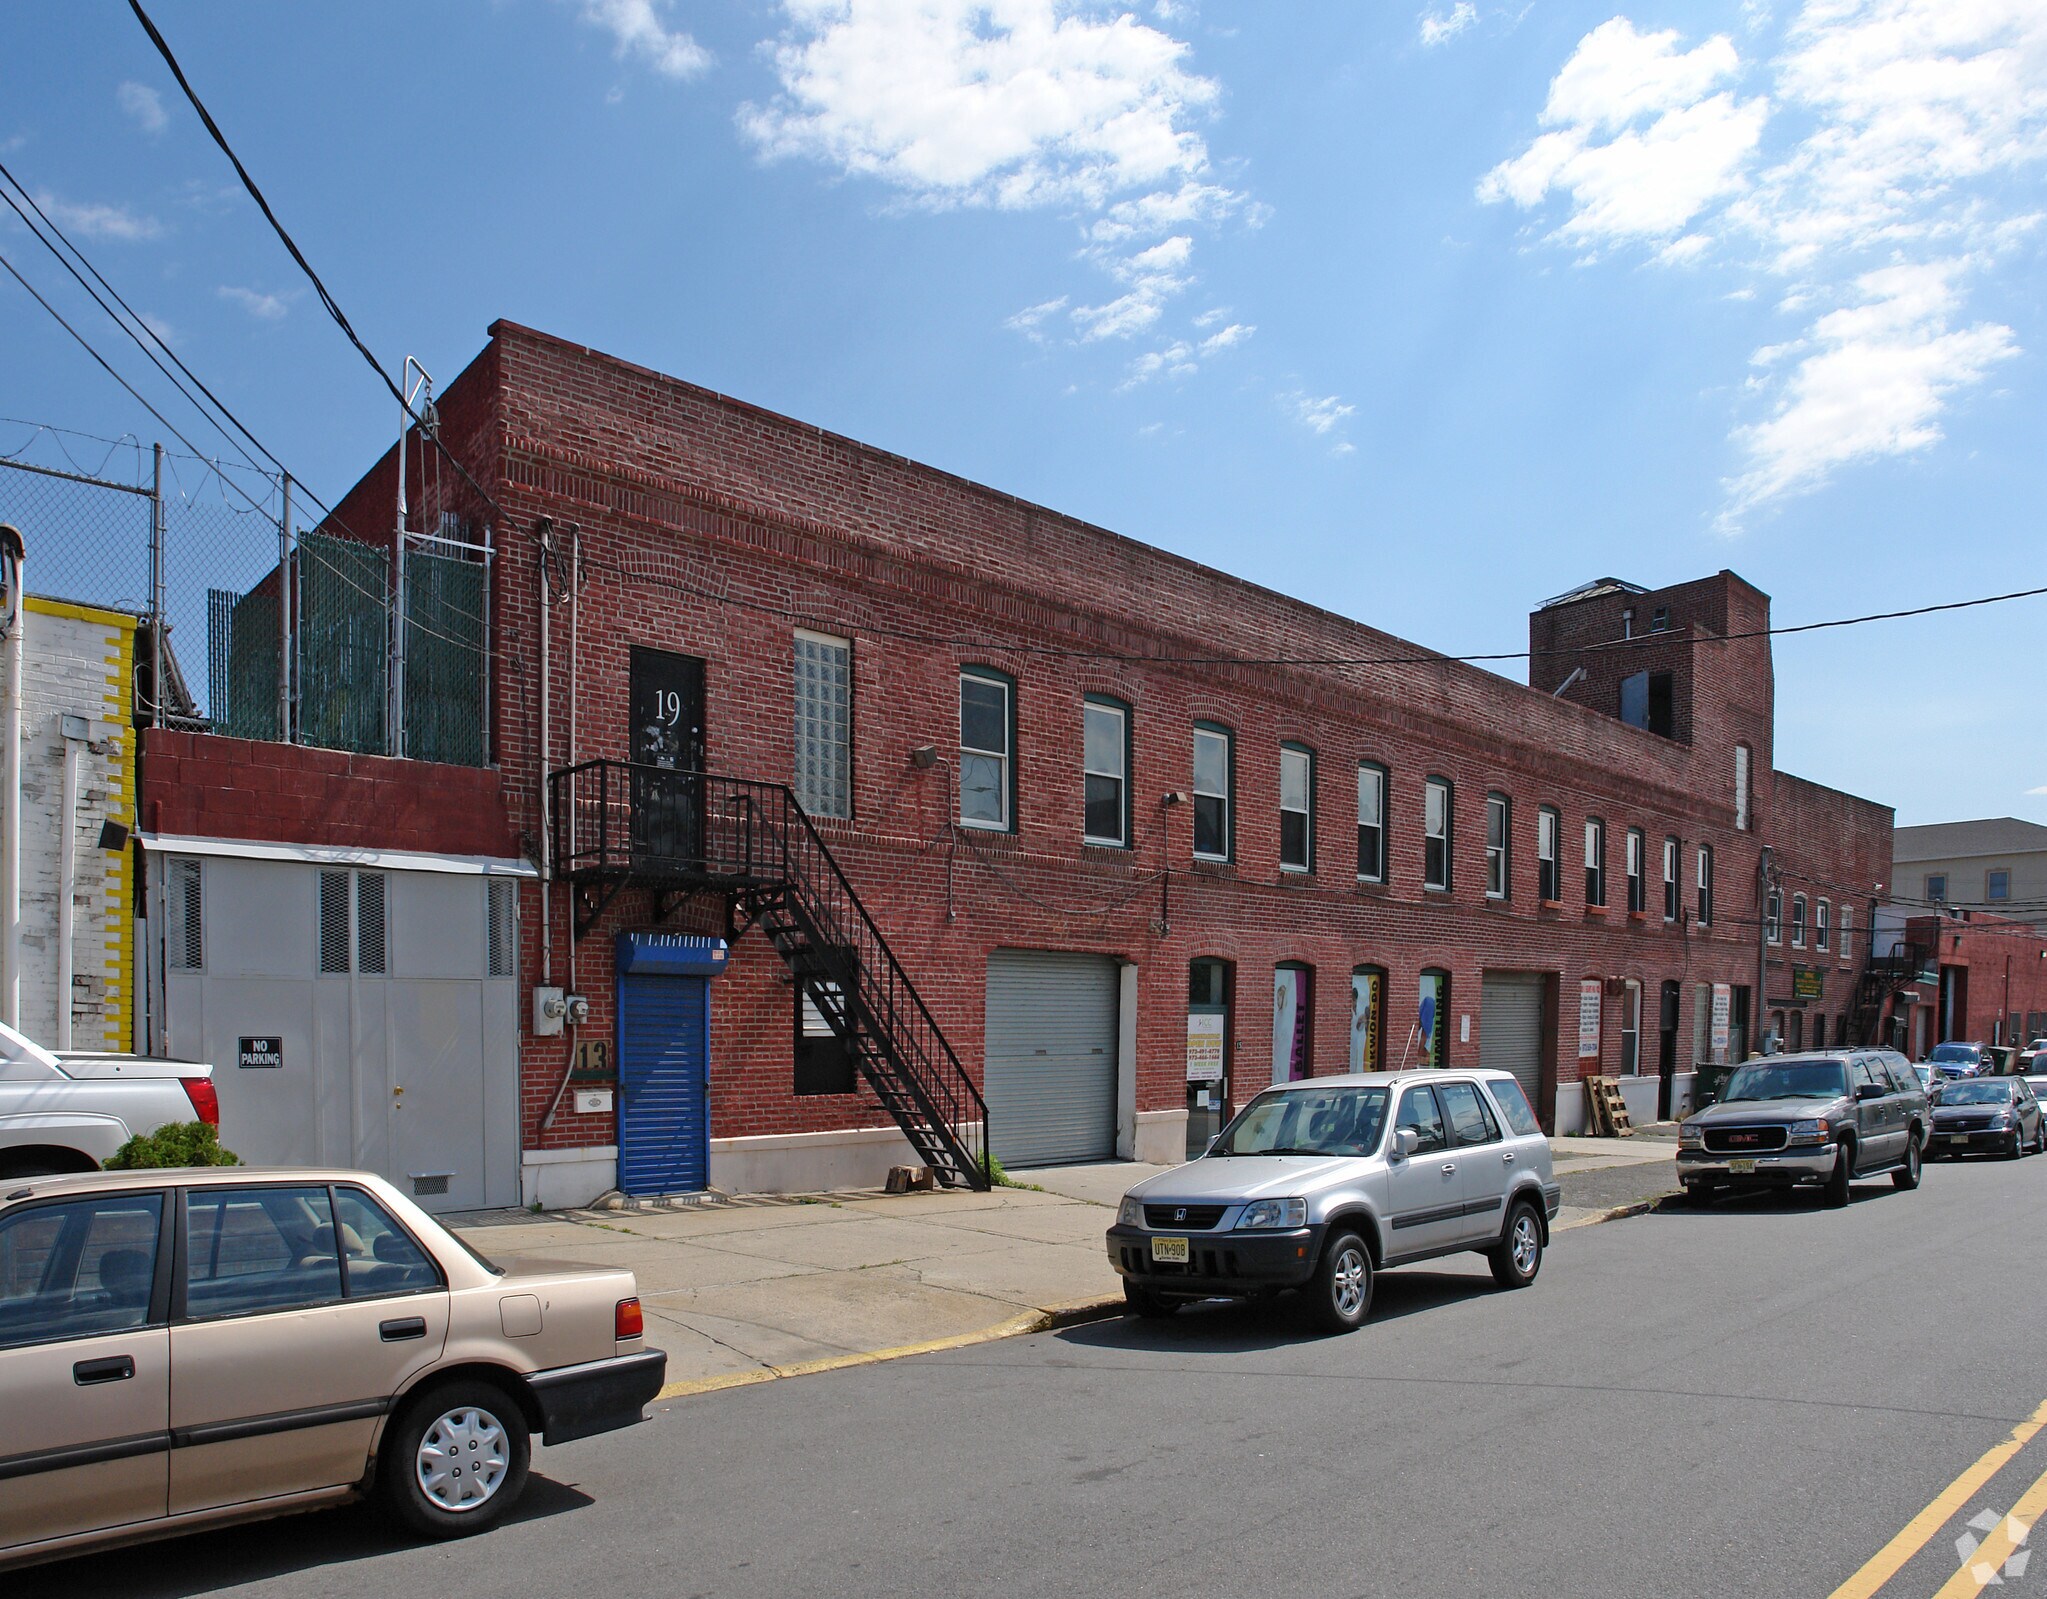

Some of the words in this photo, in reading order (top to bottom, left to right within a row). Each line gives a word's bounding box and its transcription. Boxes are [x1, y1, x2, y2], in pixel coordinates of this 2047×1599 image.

[655, 689, 681, 726] 19
[253, 1040, 268, 1052] NO
[1295, 1003, 1306, 1073] BALLET
[241, 1053, 280, 1065] PARKING
[580, 1041, 607, 1068] 13
[1729, 1134, 1759, 1143] GMC
